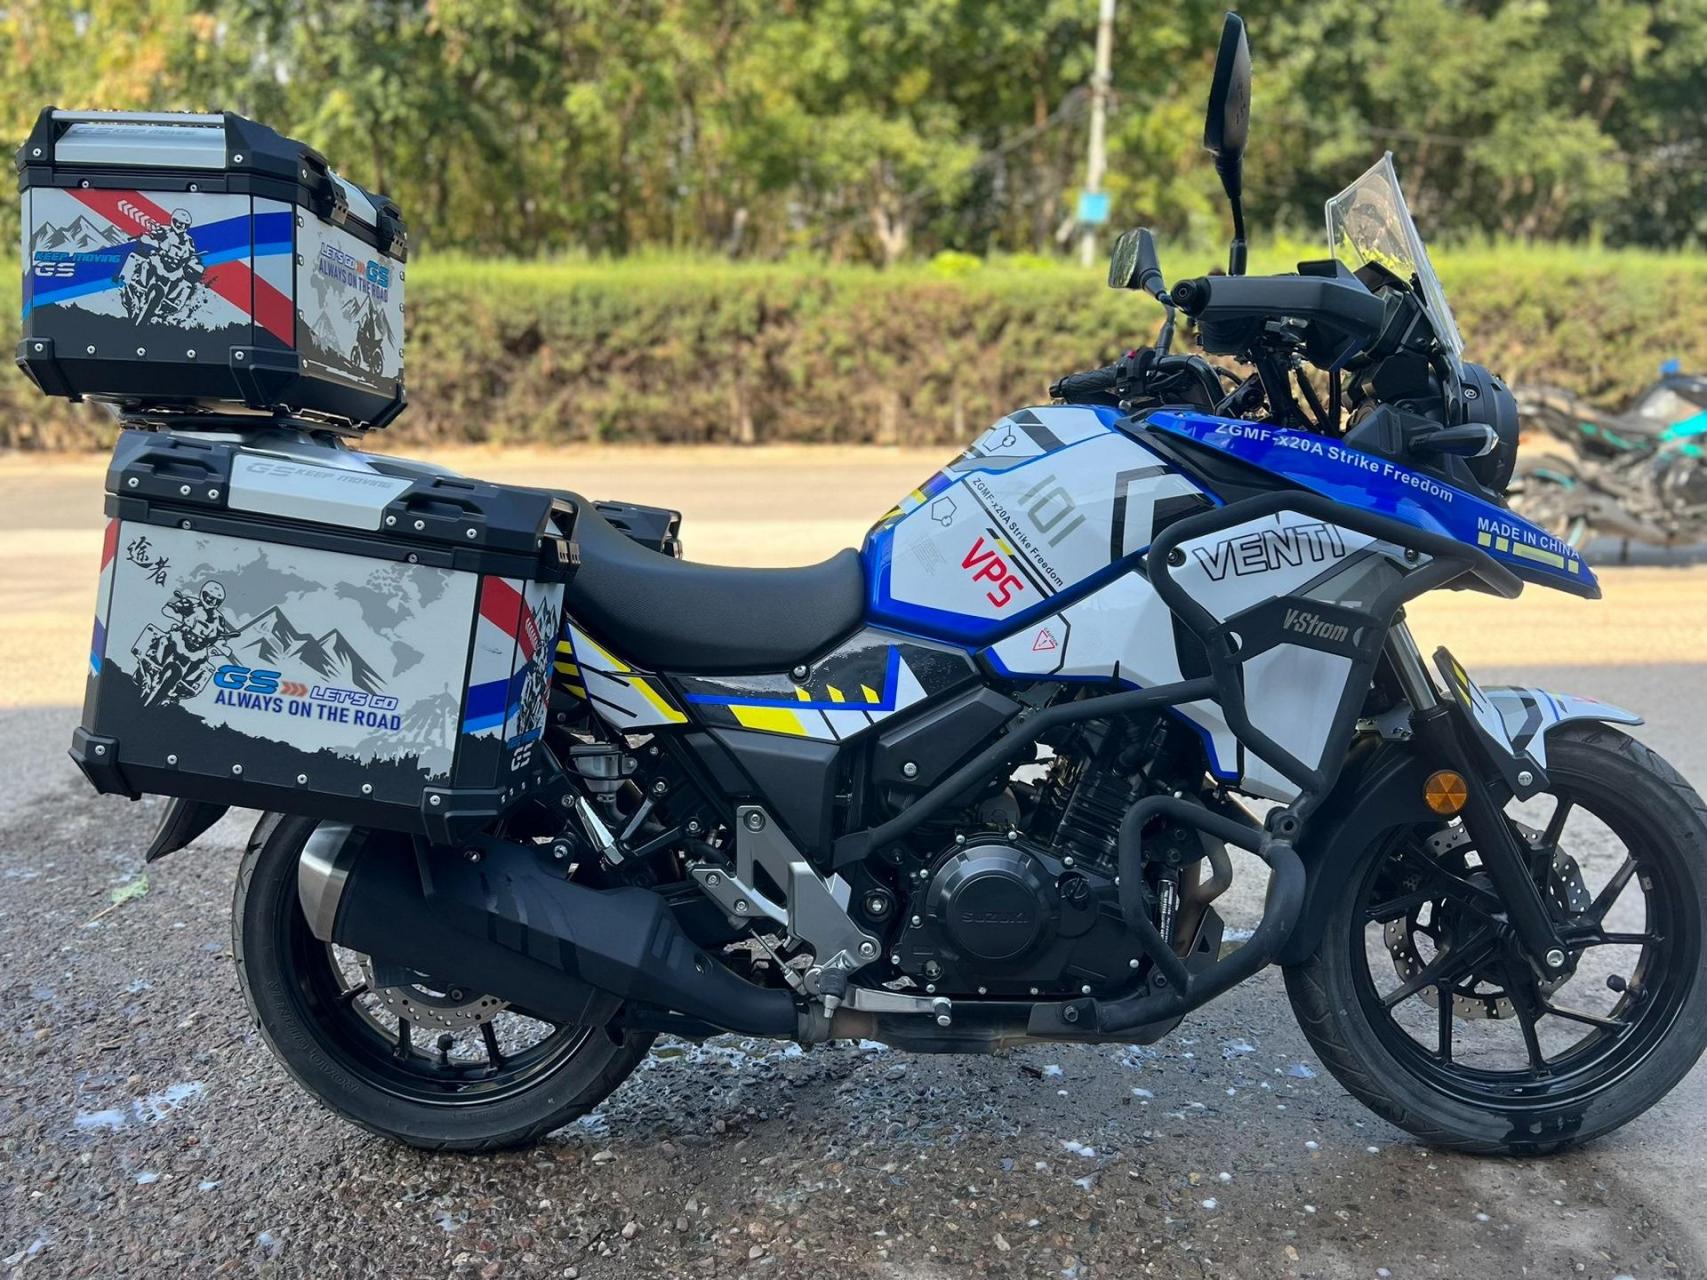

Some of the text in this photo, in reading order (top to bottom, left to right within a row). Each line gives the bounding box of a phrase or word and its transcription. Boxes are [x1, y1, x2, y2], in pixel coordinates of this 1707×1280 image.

[34, 251, 70, 262] KEEP
[34, 262, 75, 277] GS
[367, 259, 389, 288] GS
[320, 258, 347, 284] ALWAYS
[347, 272, 358, 288] ON
[359, 277, 372, 295] THE
[245, 462, 297, 477] GS
[294, 468, 335, 480] KEEP
[1327, 446, 1379, 473] Strike
[1383, 463, 1454, 503] Freedom
[1008, 521, 1031, 550] Strike
[1030, 547, 1064, 587] Freedom
[1192, 523, 1345, 582] VENTI
[1477, 516, 1580, 560] MADE IN CHINA
[1282, 607, 1349, 643] V-Strom
[213, 664, 399, 711] GS LET'S GO
[214, 690, 401, 731] ALWAYS ON THE ROAD
[510, 740, 535, 772] GS
[960, 911, 1029, 925] SUZUKI
